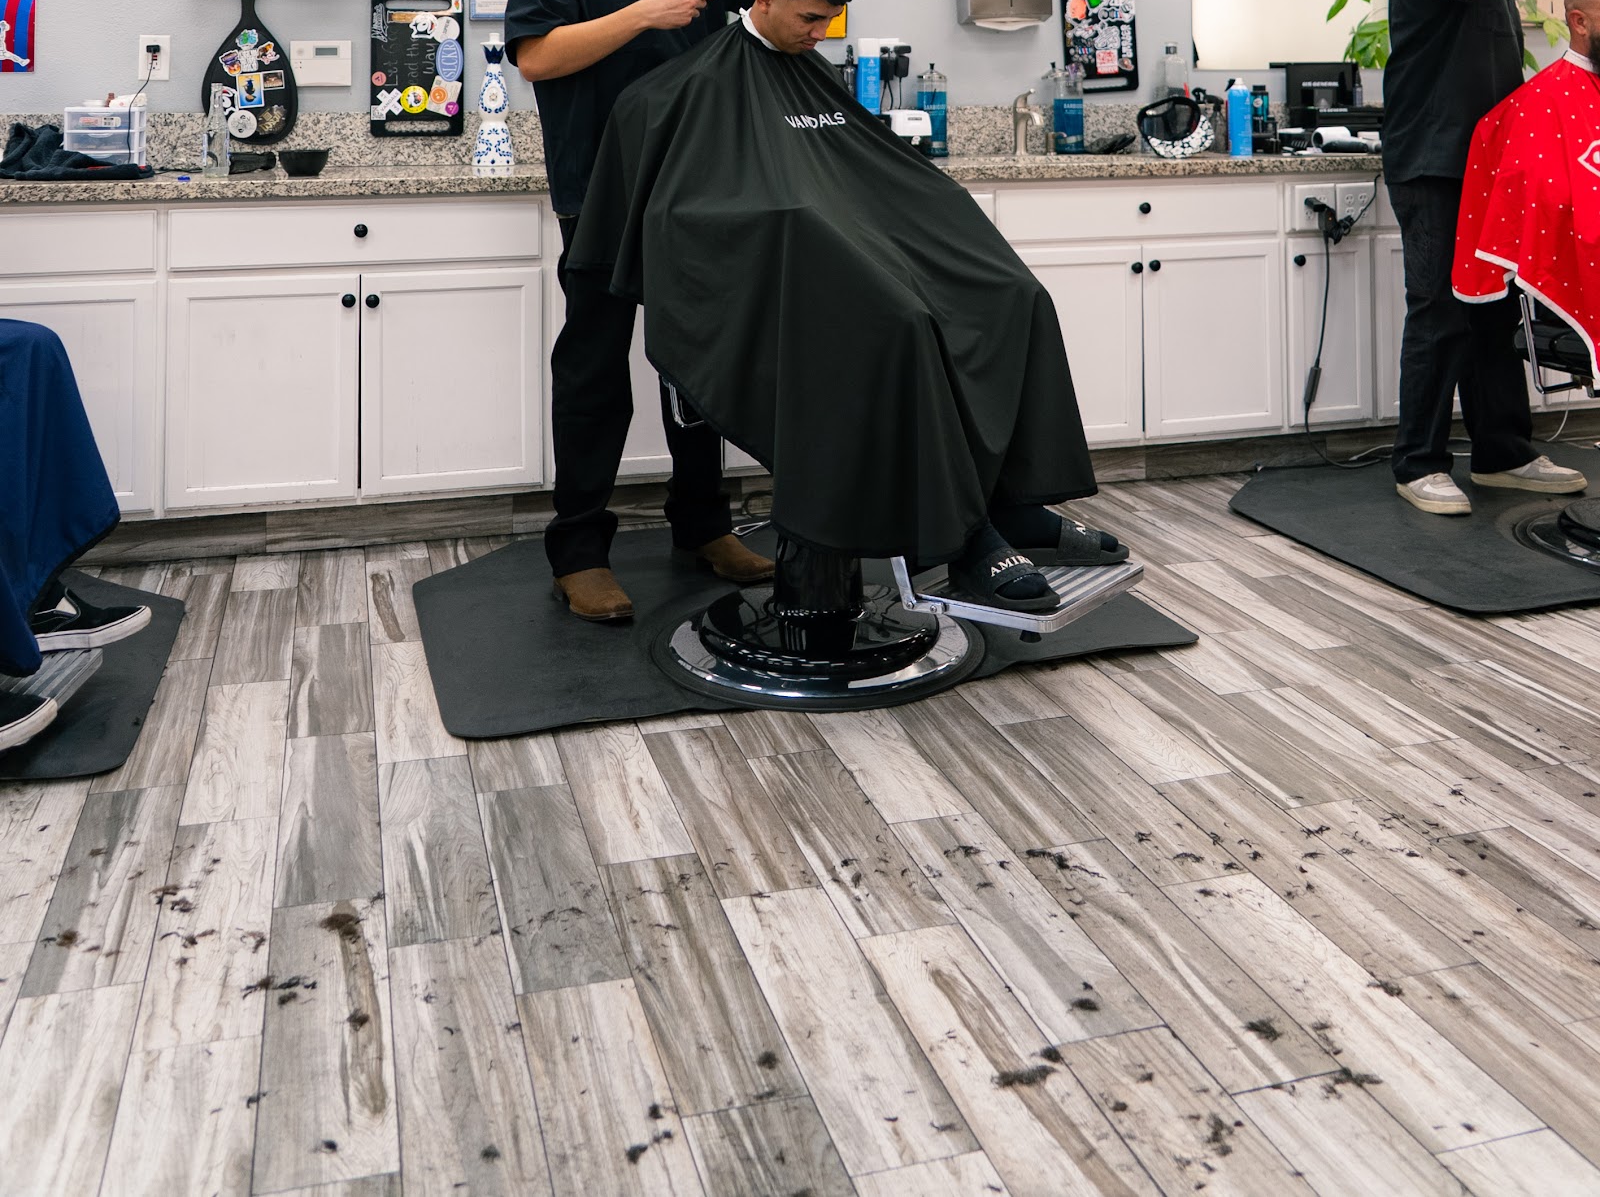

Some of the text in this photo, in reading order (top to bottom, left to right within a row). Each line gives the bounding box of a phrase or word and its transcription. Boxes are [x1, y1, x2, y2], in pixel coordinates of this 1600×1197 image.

[422, 43, 438, 75] Way
[441, 42, 458, 78] SLCKR
[784, 112, 846, 129] VANDALS
